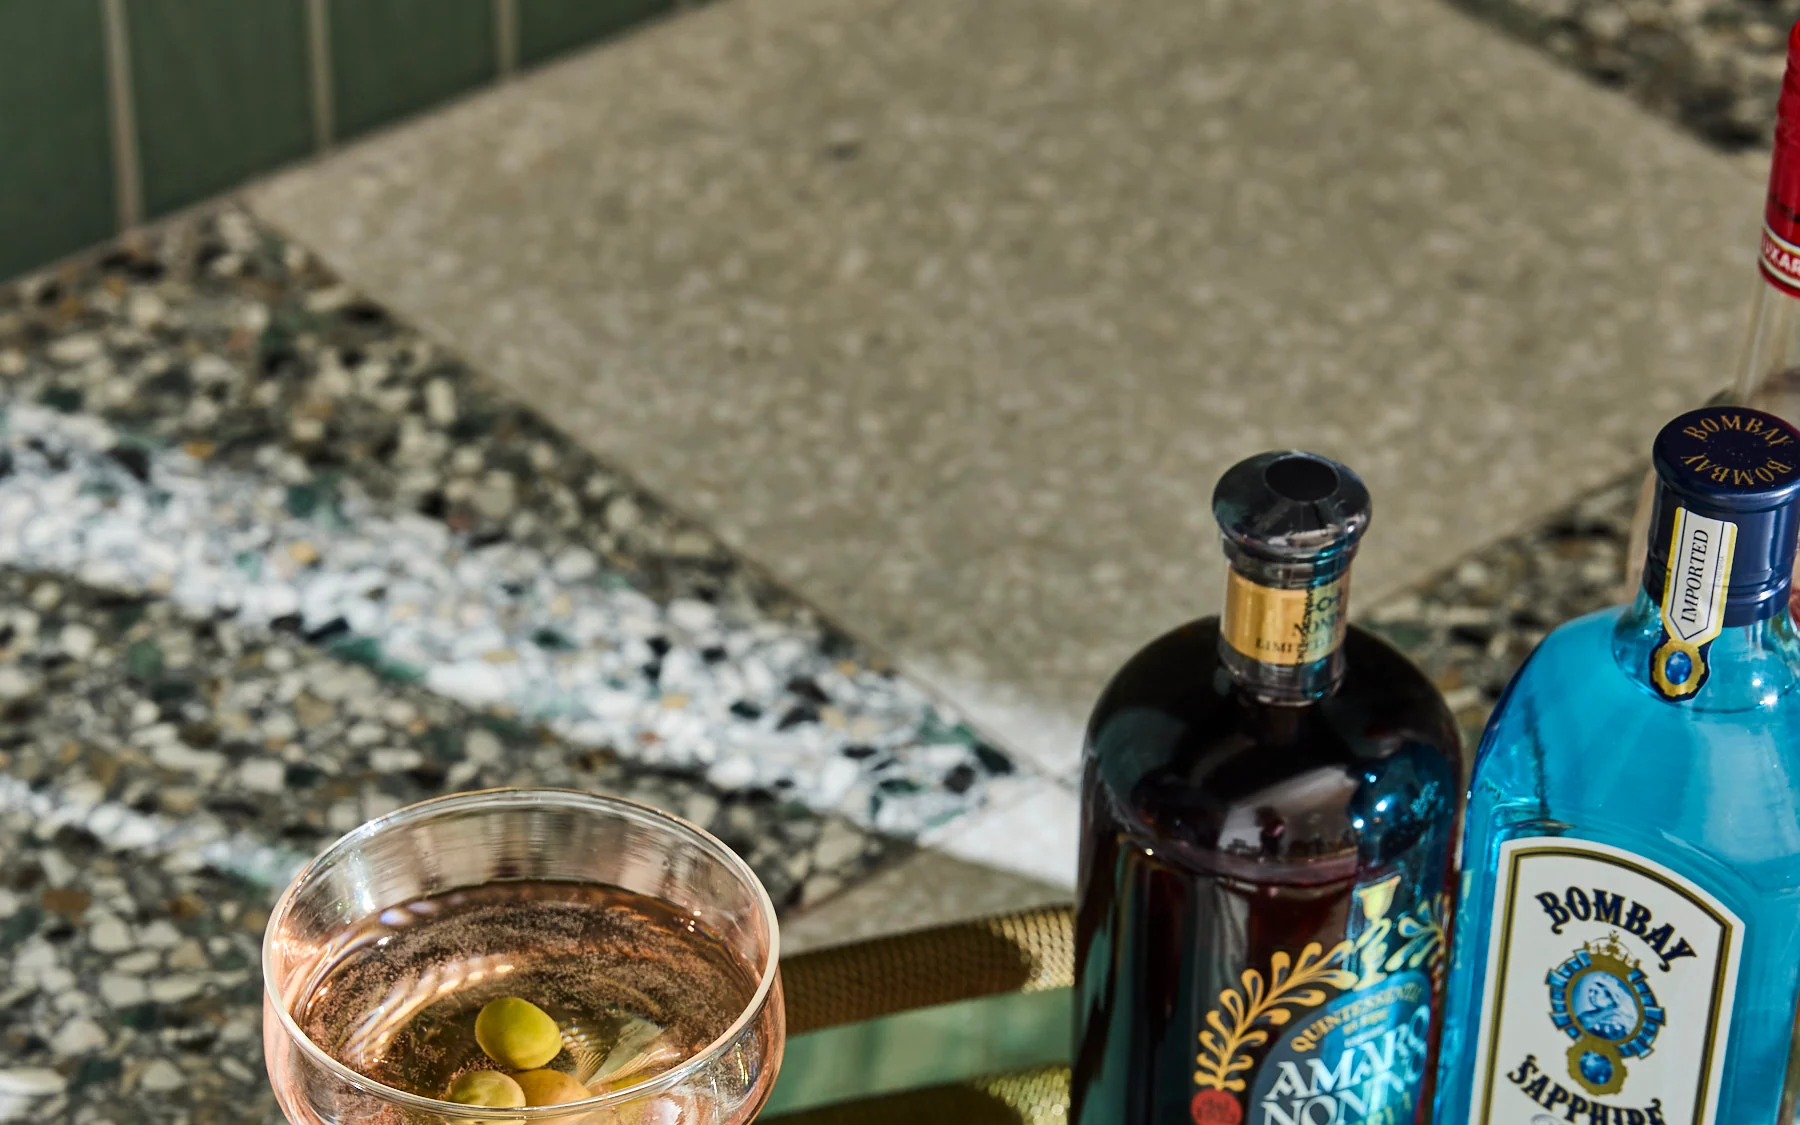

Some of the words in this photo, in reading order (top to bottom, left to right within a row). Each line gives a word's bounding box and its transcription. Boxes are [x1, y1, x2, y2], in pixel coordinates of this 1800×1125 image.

[1680, 454, 1793, 486] BOMBAY
[1682, 414, 1794, 448] BOMBAY
[1681, 529, 1709, 623] IMPORTED
[1535, 886, 1698, 973] BOMBAY
[1263, 1004, 1431, 1101] AMARO
